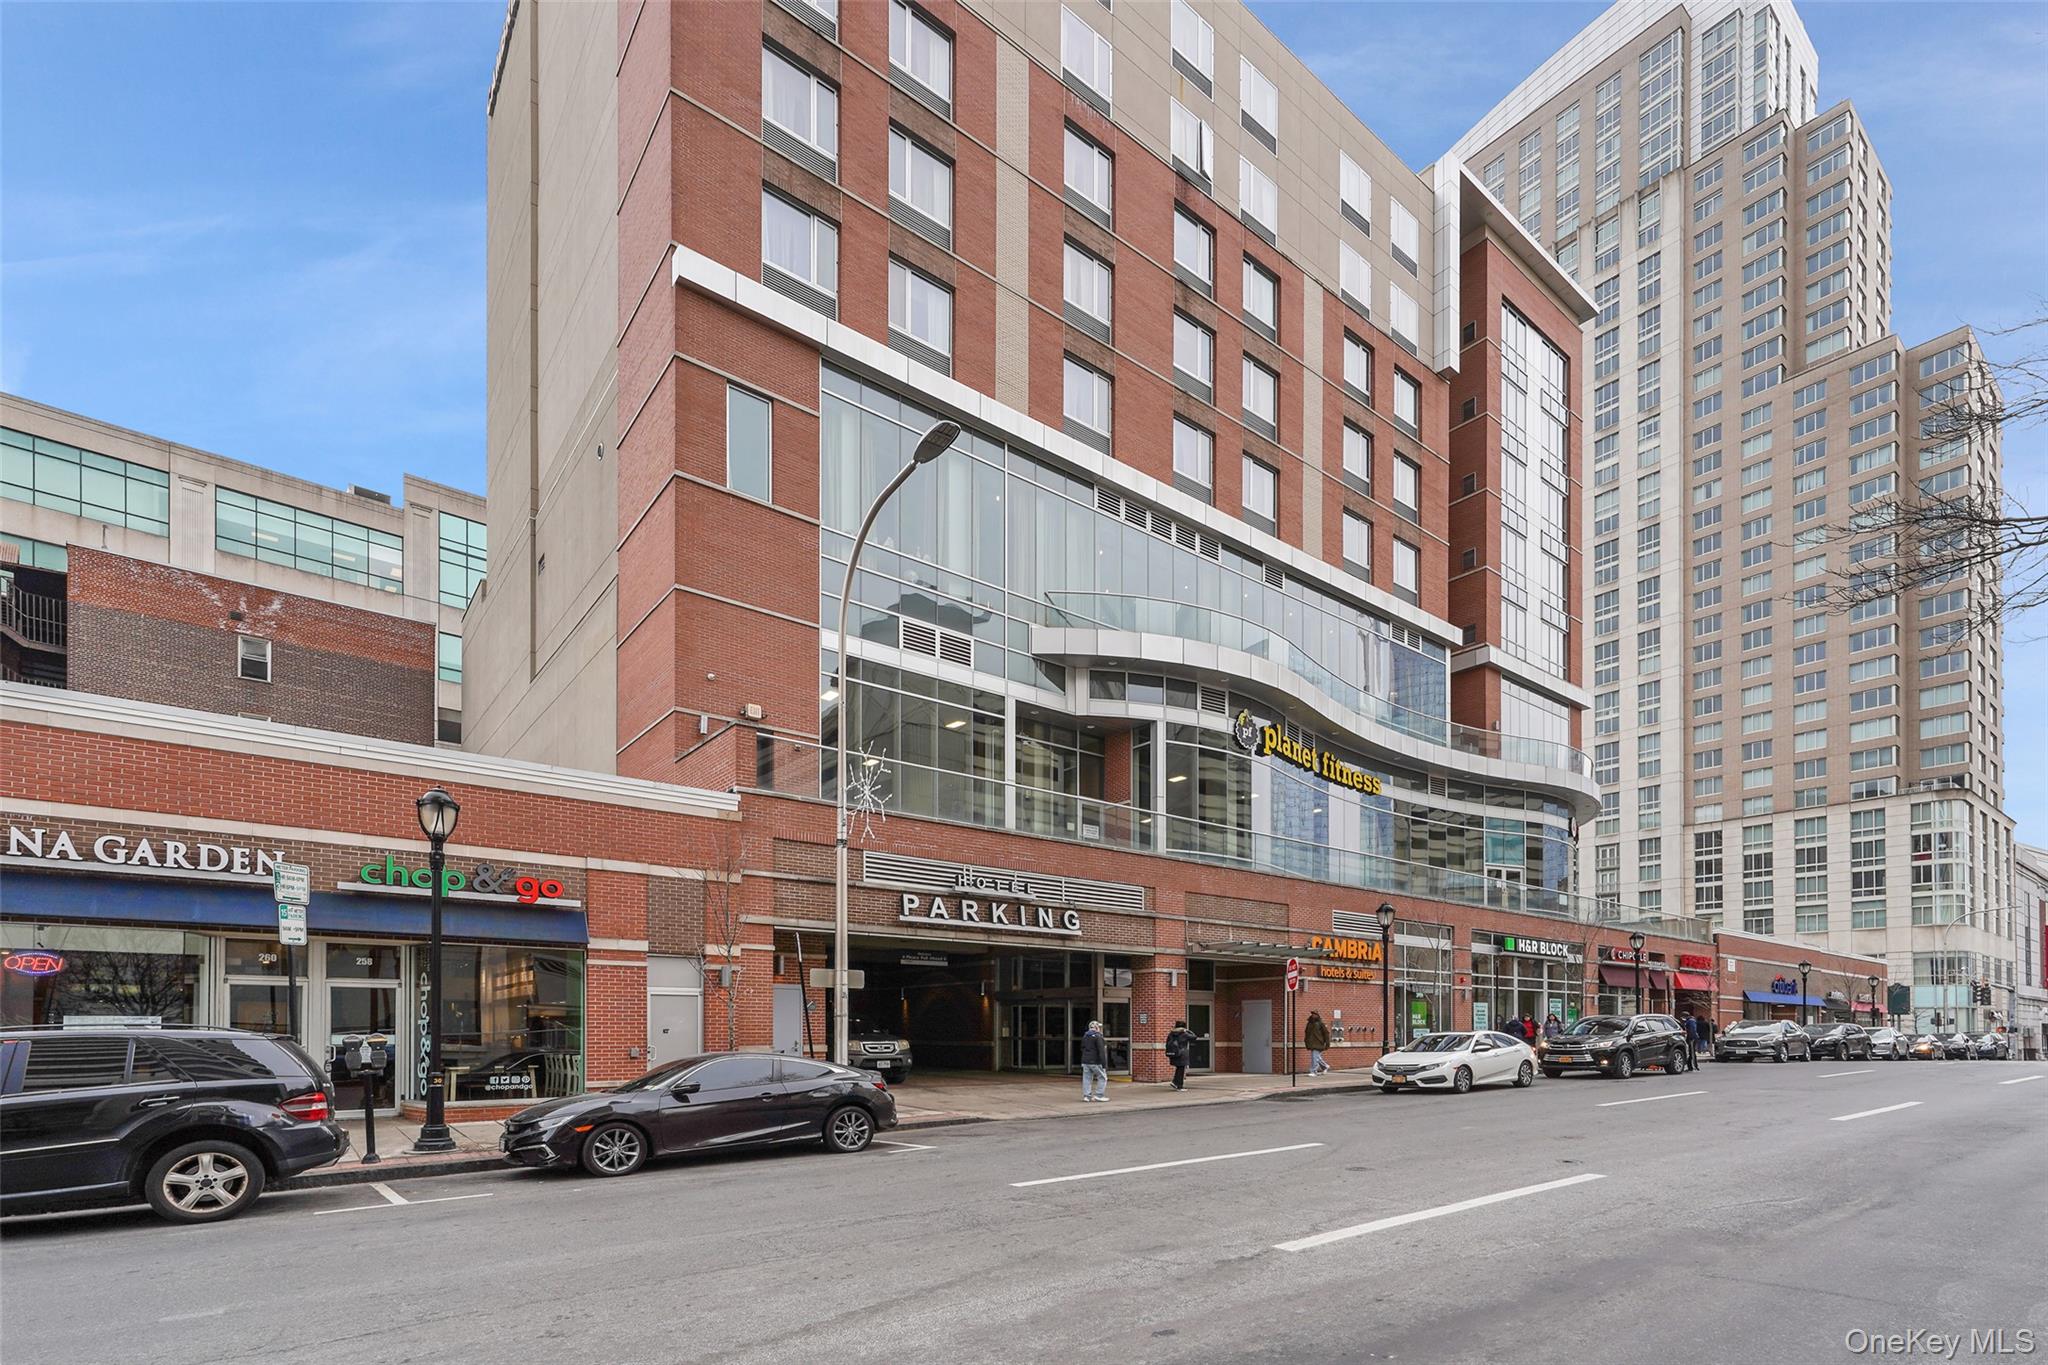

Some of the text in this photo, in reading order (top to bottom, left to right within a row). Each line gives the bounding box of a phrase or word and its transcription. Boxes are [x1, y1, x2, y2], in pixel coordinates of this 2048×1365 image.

[1242, 726, 1252, 738] pf
[1264, 724, 1382, 795] planet fitness
[6, 826, 285, 876] NA GARDEN
[361, 854, 466, 897] chop
[515, 876, 564, 904] go
[958, 874, 1034, 894] HOTEL
[902, 893, 1080, 930] PARKING
[1519, 939, 1568, 956] H&R BLOCK
[4, 955, 64, 973] OPEN
[258, 953, 277, 962] 260
[356, 957, 373, 966] 258
[1321, 965, 1345, 978] hotels
[1346, 967, 1353, 978] &
